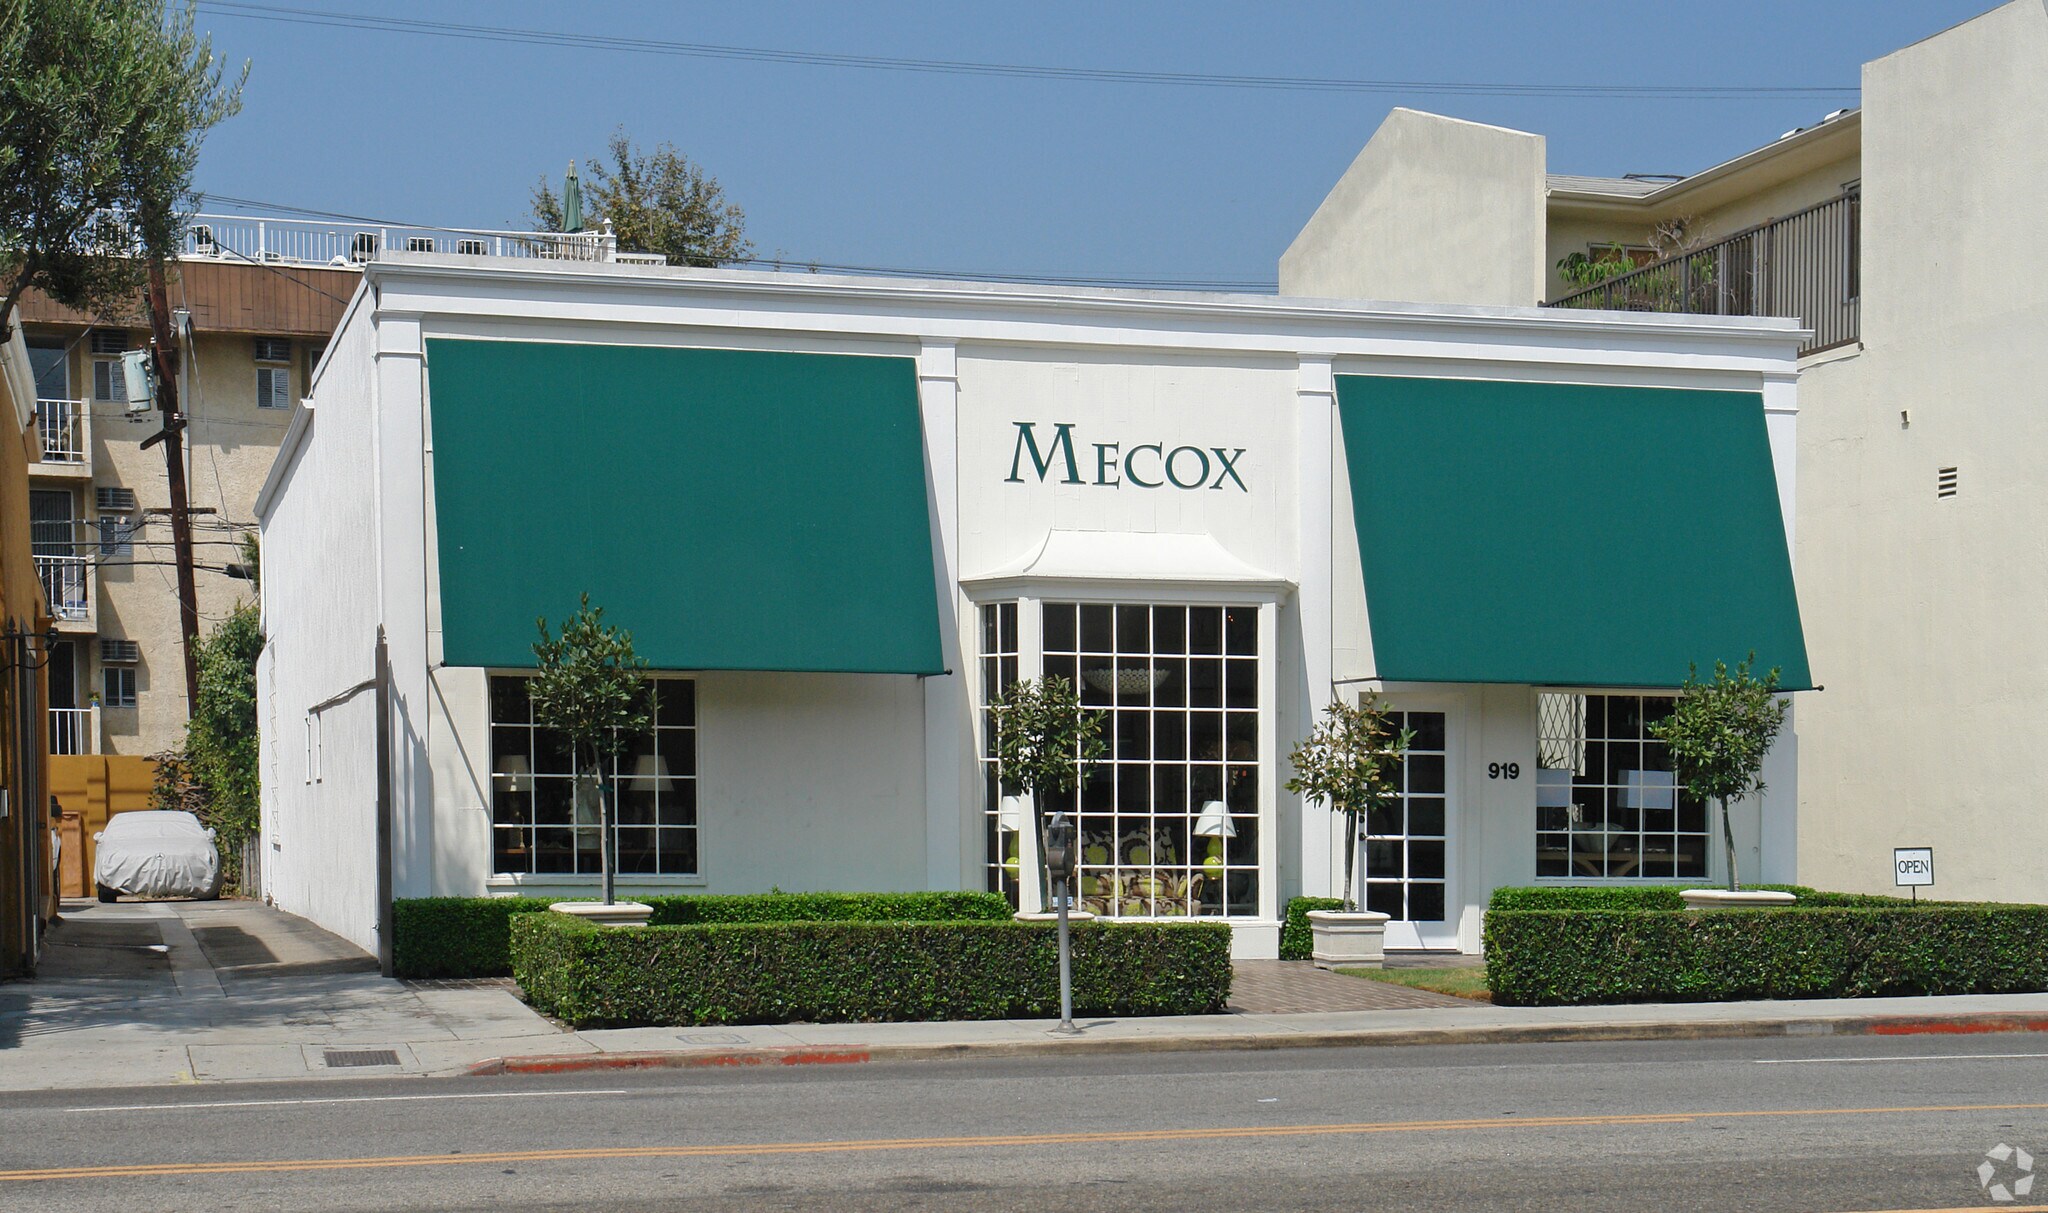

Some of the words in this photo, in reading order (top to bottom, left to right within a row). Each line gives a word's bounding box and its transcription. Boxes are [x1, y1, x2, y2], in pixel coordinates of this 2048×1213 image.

[1004, 421, 1248, 493] MECOX
[1488, 762, 1520, 779] 919
[1898, 860, 1929, 874] OPEN
